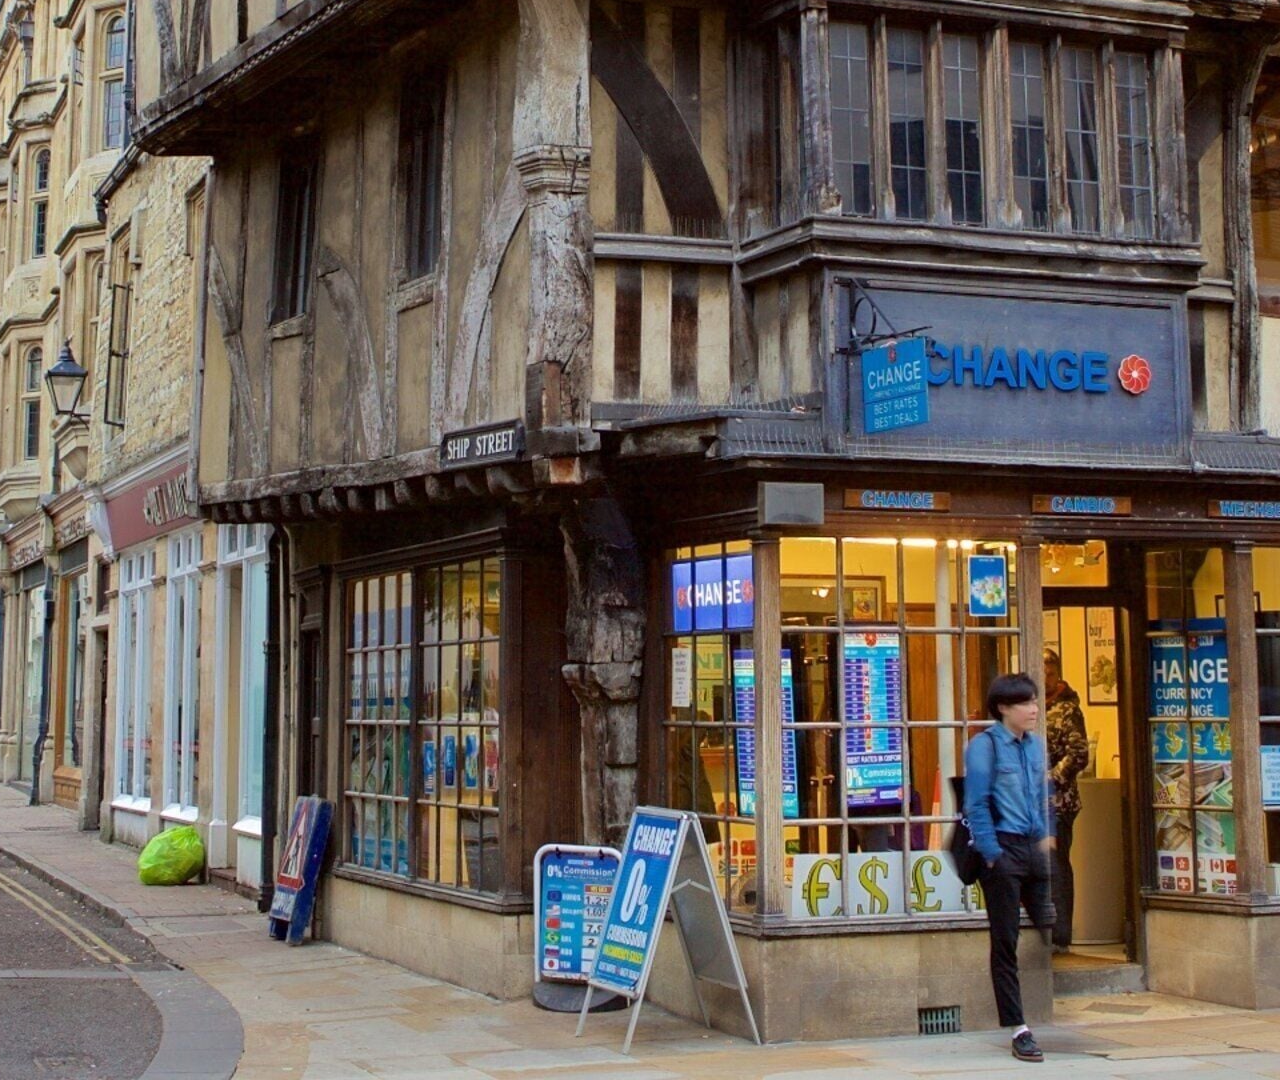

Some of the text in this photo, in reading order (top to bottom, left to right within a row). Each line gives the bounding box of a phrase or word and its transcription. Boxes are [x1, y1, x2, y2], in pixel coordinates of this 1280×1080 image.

[867, 360, 922, 390] CHANGE
[926, 342, 1111, 394] CHANGE
[874, 396, 918, 416] BEST RATES
[874, 410, 919, 429] BEST DEALS
[447, 429, 516, 461] SHIP STREET
[862, 489, 934, 509] CHANGE
[1051, 496, 1116, 513] CAMBIO
[686, 579, 742, 608] CHANGE
[1156, 687, 1214, 700] CURRNCY
[883, 754, 902, 762] OXFOR
[863, 769, 902, 778] Commissio
[633, 824, 677, 856] CHANGE
[547, 865, 562, 877] 0%
[620, 858, 652, 925] 0%
[801, 855, 942, 916] € $ £
[585, 895, 610, 907] 1.25
[606, 923, 648, 949] COMMISSION
